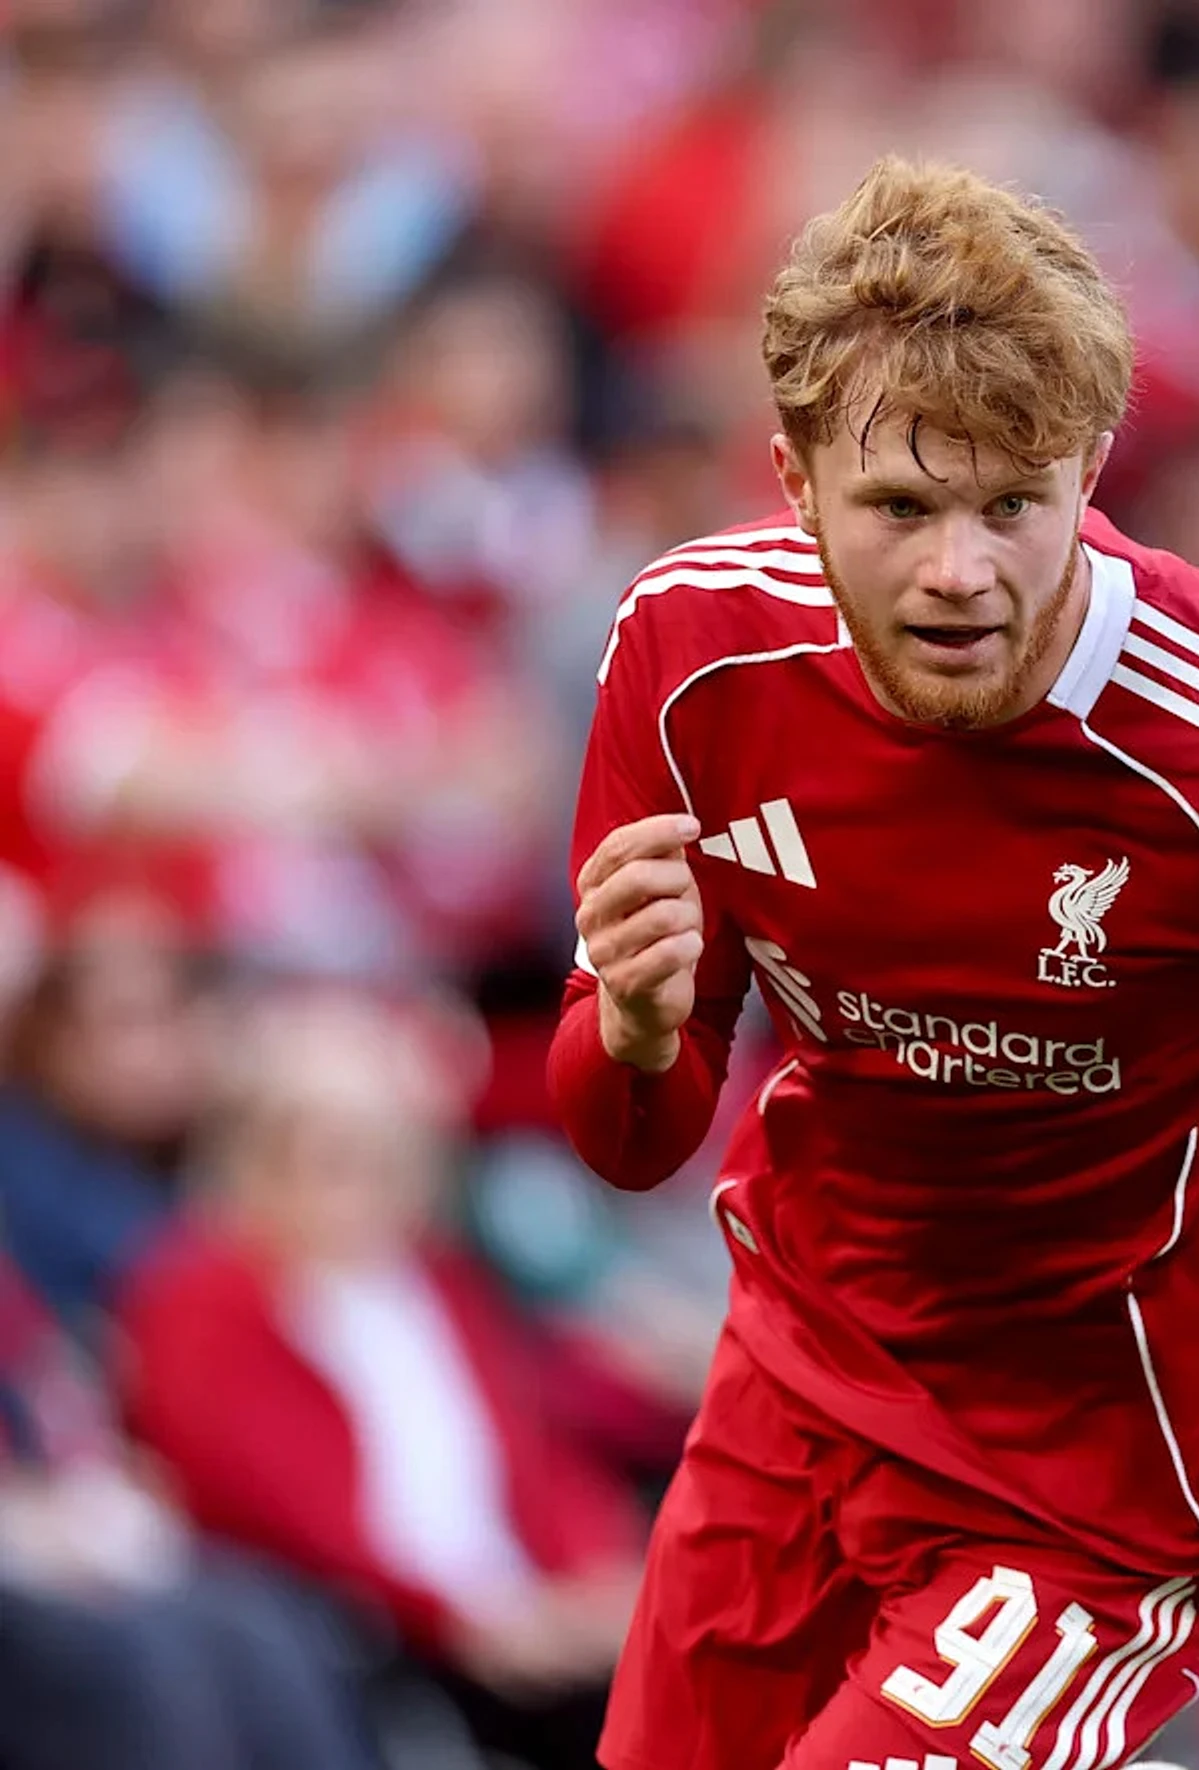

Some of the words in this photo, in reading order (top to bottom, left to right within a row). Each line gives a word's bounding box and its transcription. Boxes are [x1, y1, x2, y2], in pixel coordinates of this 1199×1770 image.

[1037, 954, 1117, 988] L.F.C.
[836, 990, 1104, 1068] standard
[880, 1564, 1099, 1770] 91
